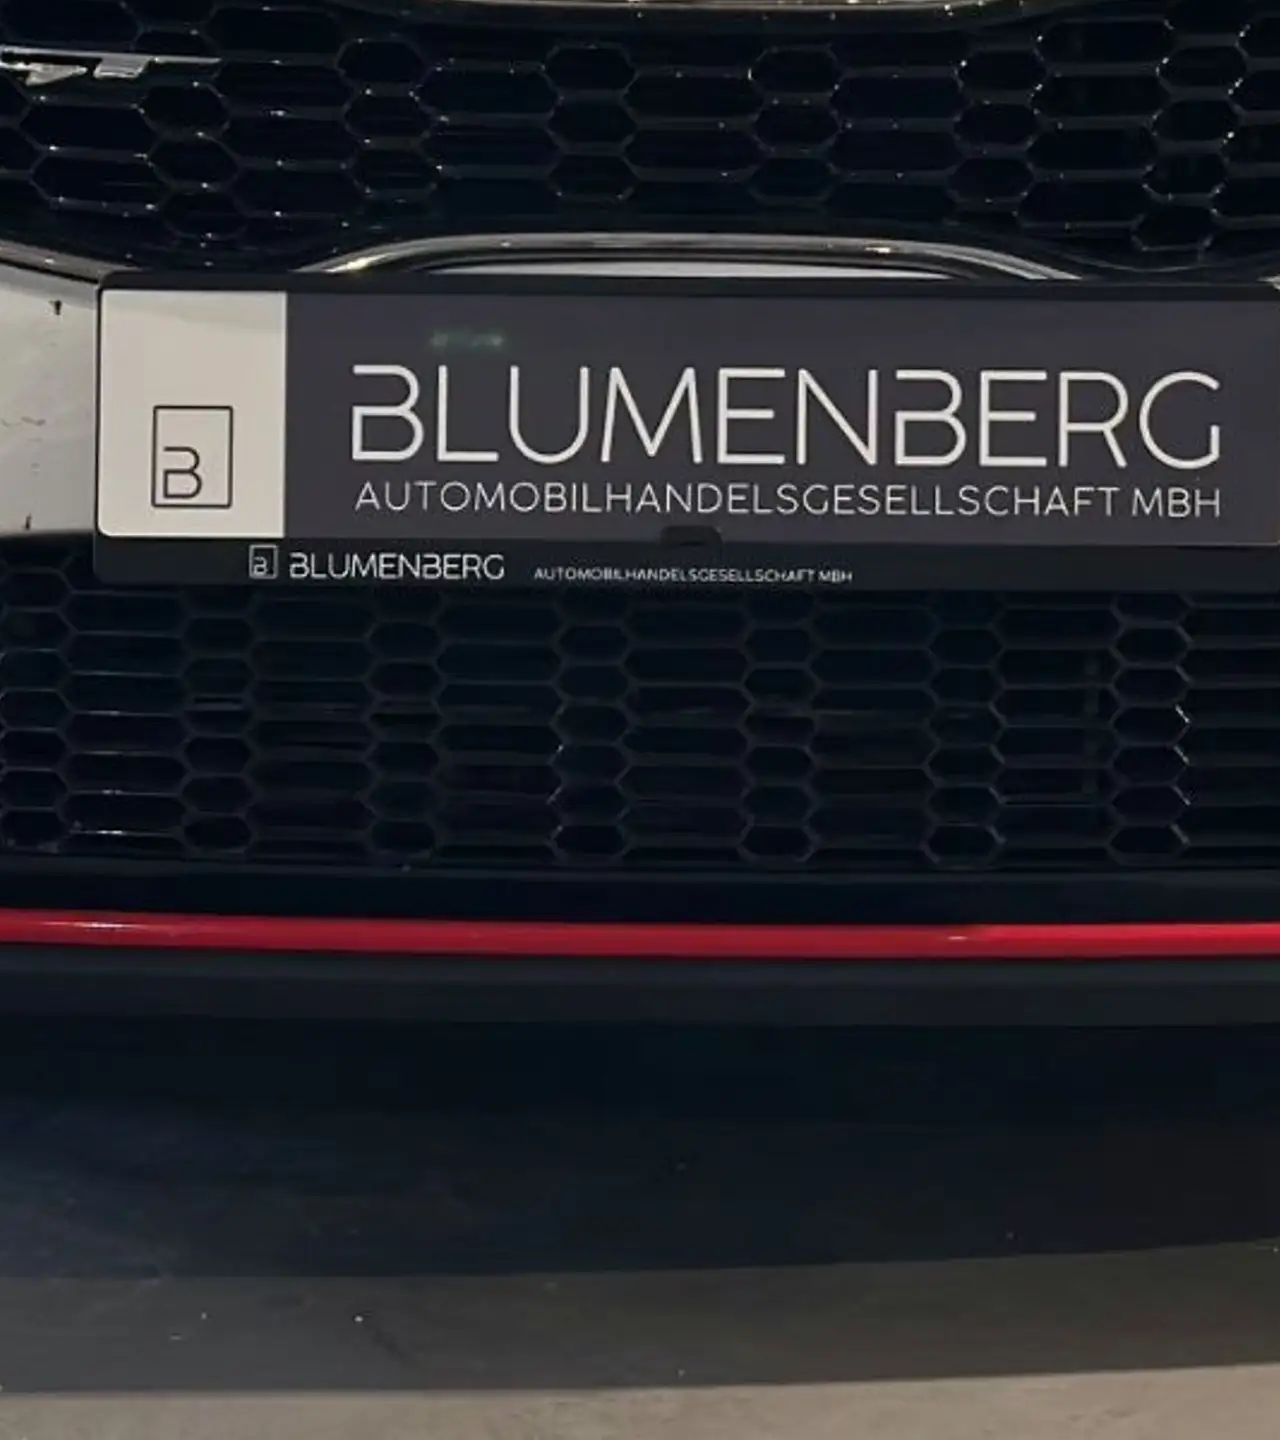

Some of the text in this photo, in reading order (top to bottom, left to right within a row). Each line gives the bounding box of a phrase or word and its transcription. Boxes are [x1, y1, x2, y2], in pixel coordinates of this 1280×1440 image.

[351, 364, 1221, 471] BLUMENBERG
[162, 445, 204, 498] B
[355, 480, 1221, 519] AUTOMOBILHANDELSGESELLSCHAFT MBH
[288, 551, 506, 581] BLUMENBERG
[533, 565, 854, 584] AUTOMOBILHANDELSGESELLSCHAFT MBH
